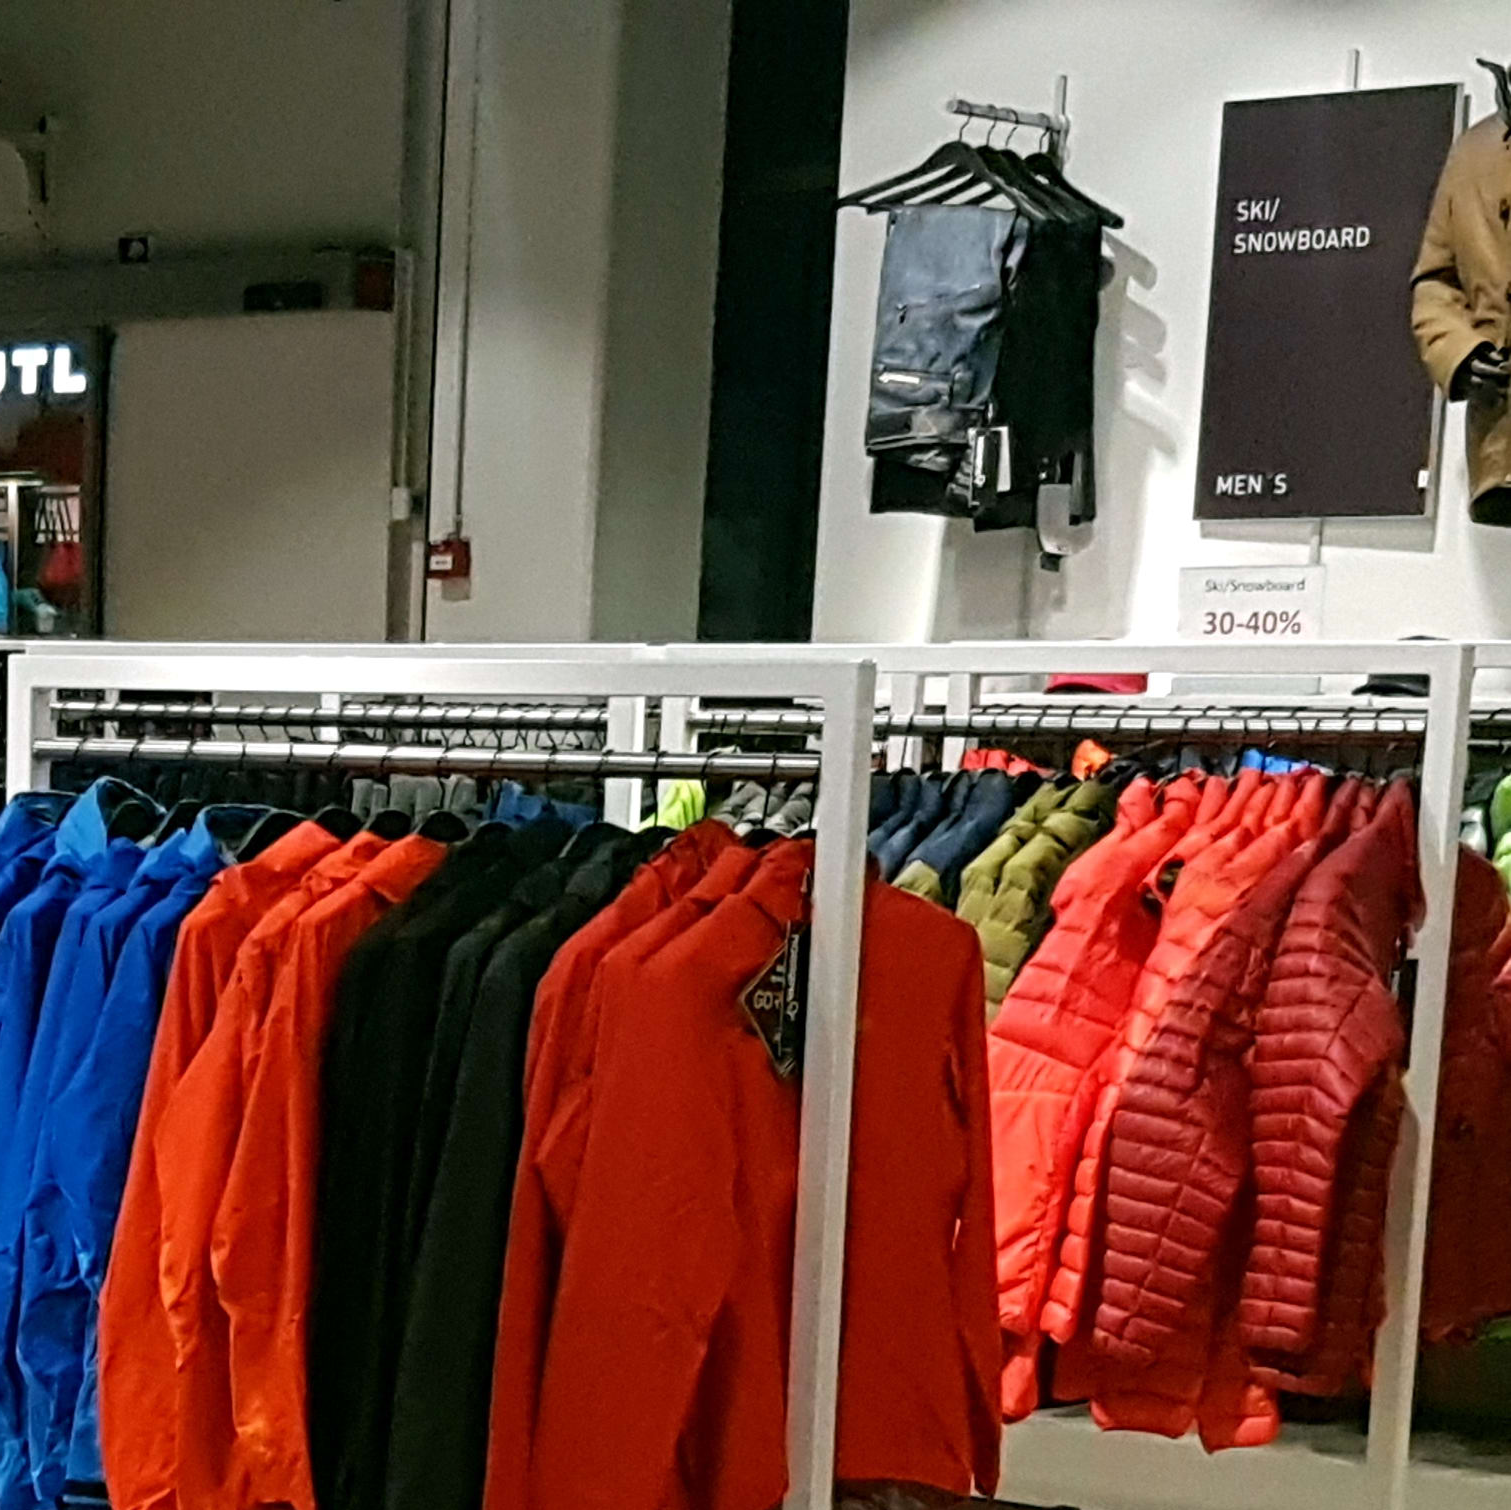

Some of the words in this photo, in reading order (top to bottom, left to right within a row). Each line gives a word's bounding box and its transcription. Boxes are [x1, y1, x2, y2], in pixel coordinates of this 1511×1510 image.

[1236, 197, 1280, 222] SKI/
[1233, 226, 1371, 254] SNOWBOARD
[1202, 609, 1302, 636] 30-40%
